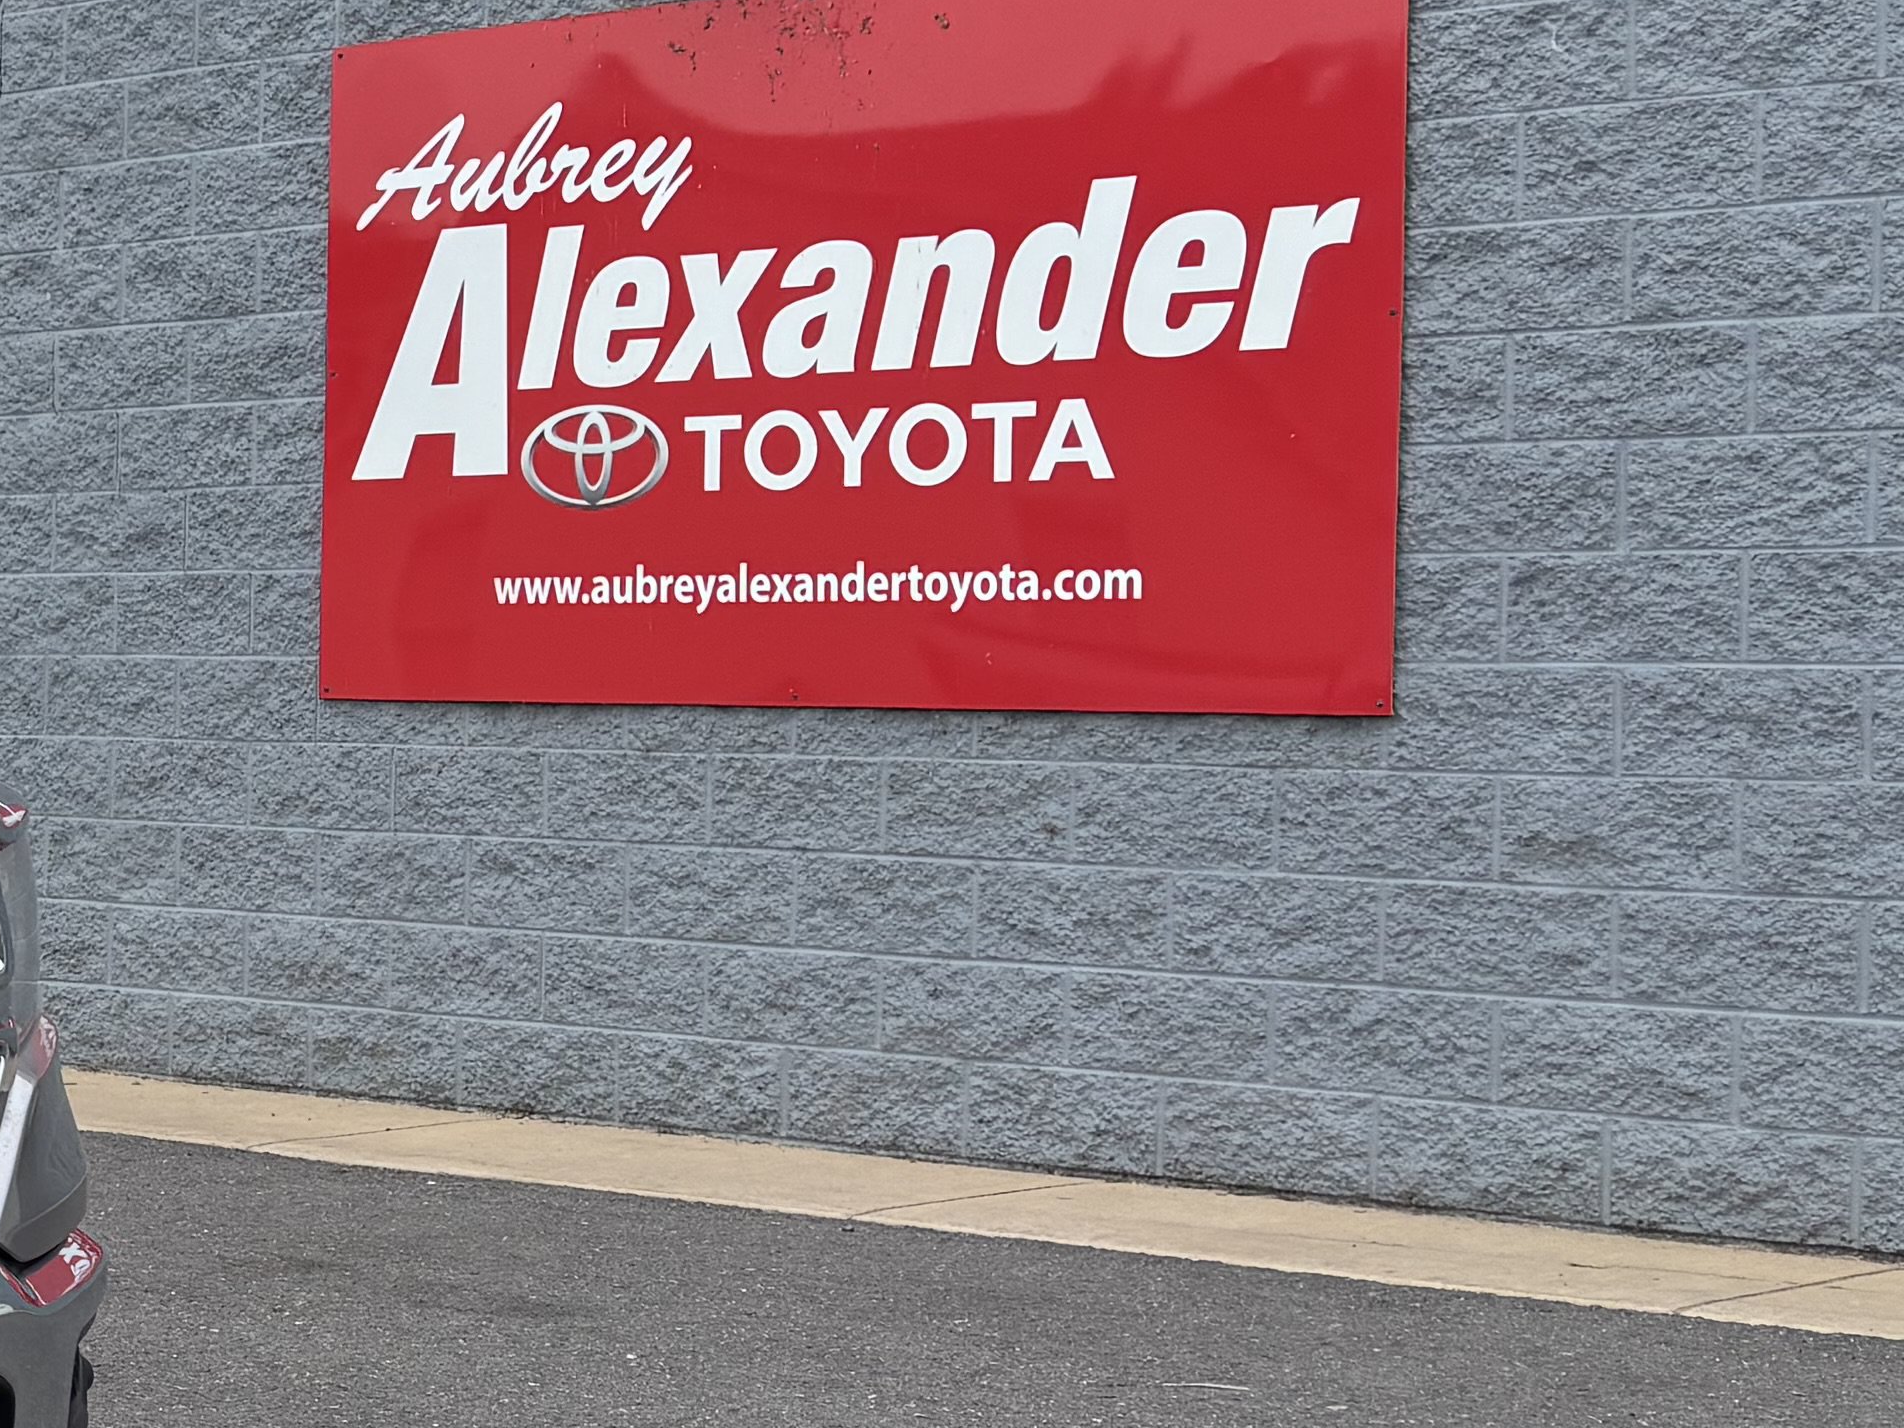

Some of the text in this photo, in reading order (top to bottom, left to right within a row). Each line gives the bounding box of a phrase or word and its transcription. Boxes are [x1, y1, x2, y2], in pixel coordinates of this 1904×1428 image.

[356, 101, 693, 231] Aubrey
[351, 175, 1361, 481] Alexander
[683, 398, 1115, 492] TOYOTA
[493, 560, 1143, 615] www.aubreyalexandertoyota.com
